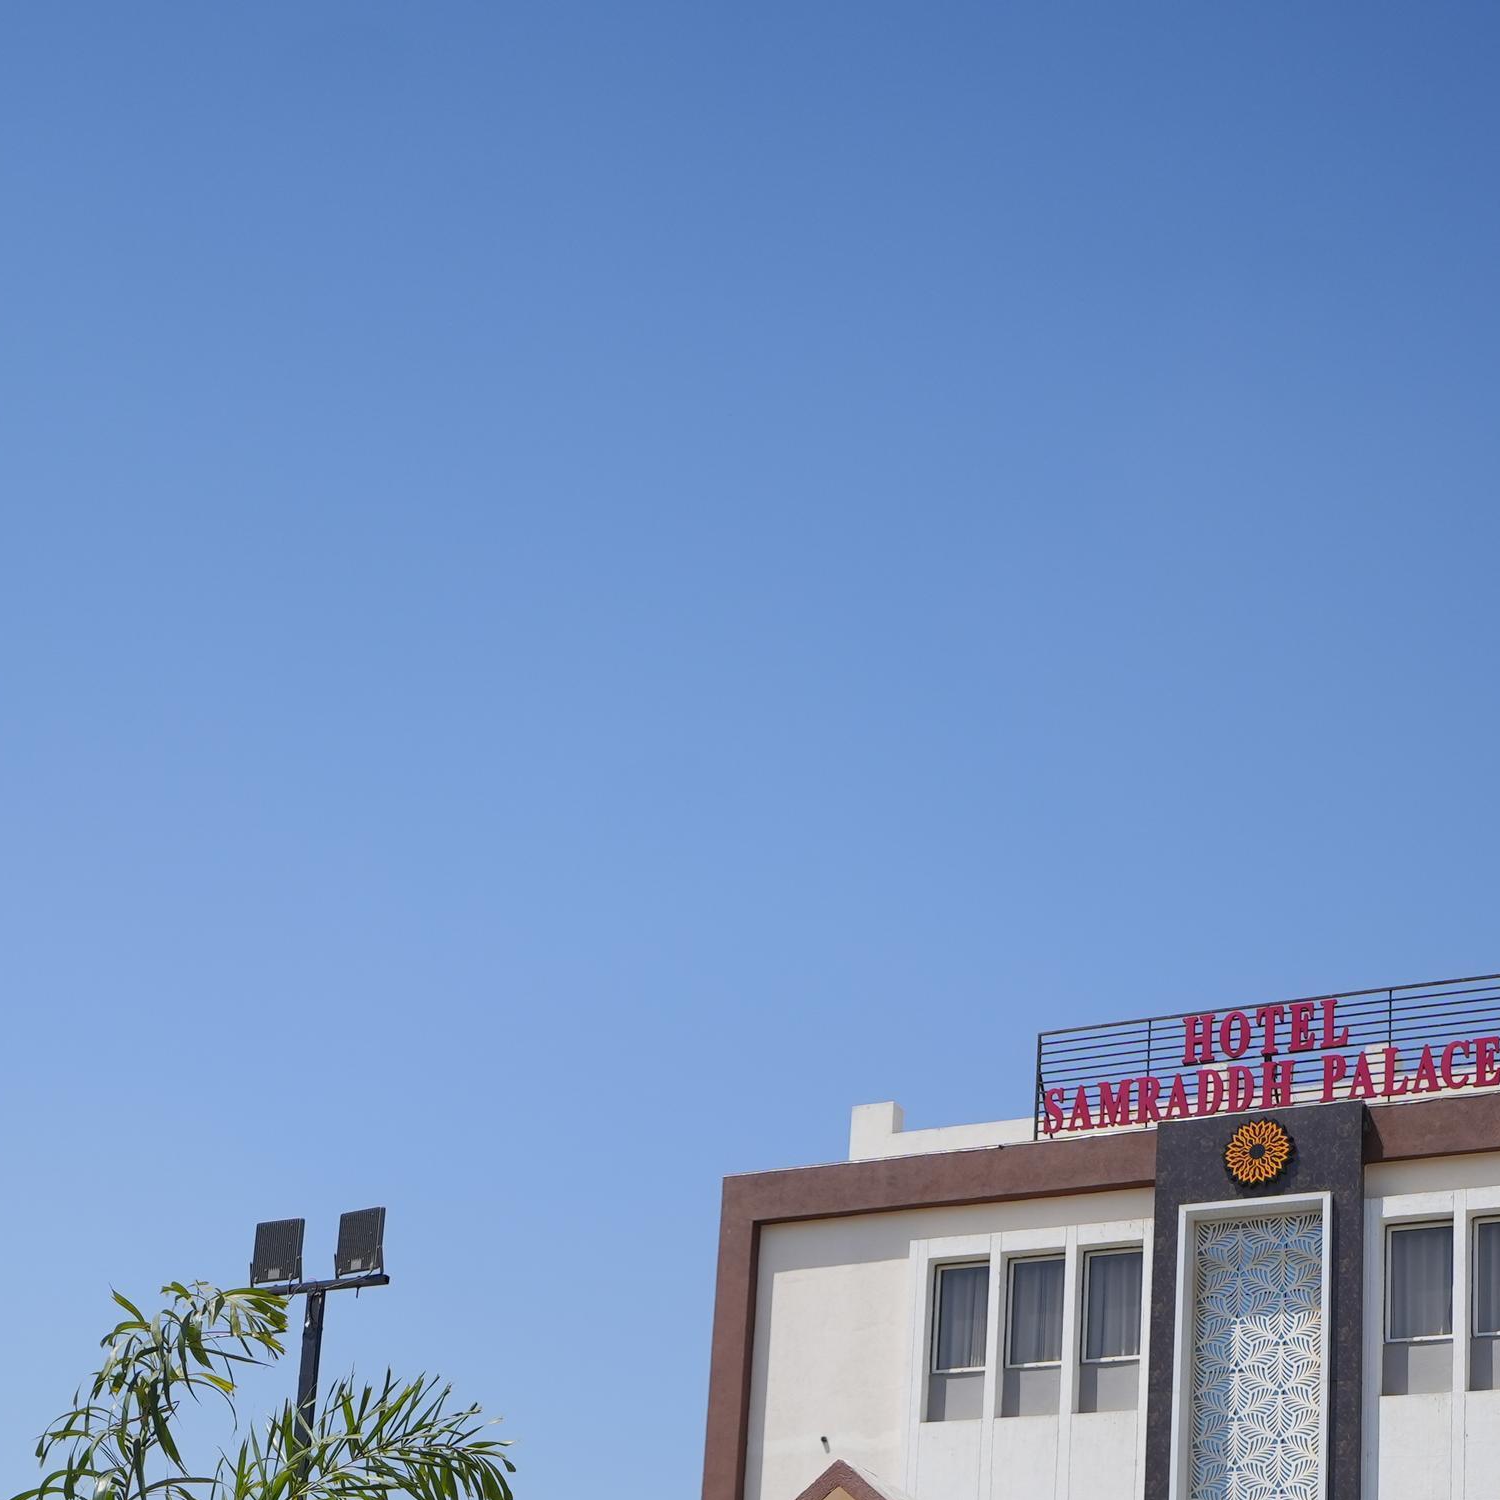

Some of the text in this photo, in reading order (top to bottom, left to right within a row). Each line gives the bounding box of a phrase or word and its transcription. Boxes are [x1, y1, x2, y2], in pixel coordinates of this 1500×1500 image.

[1182, 999, 1349, 1066] HOTEL
[1043, 1036, 1500, 1134] SAMRADDH PALACE
